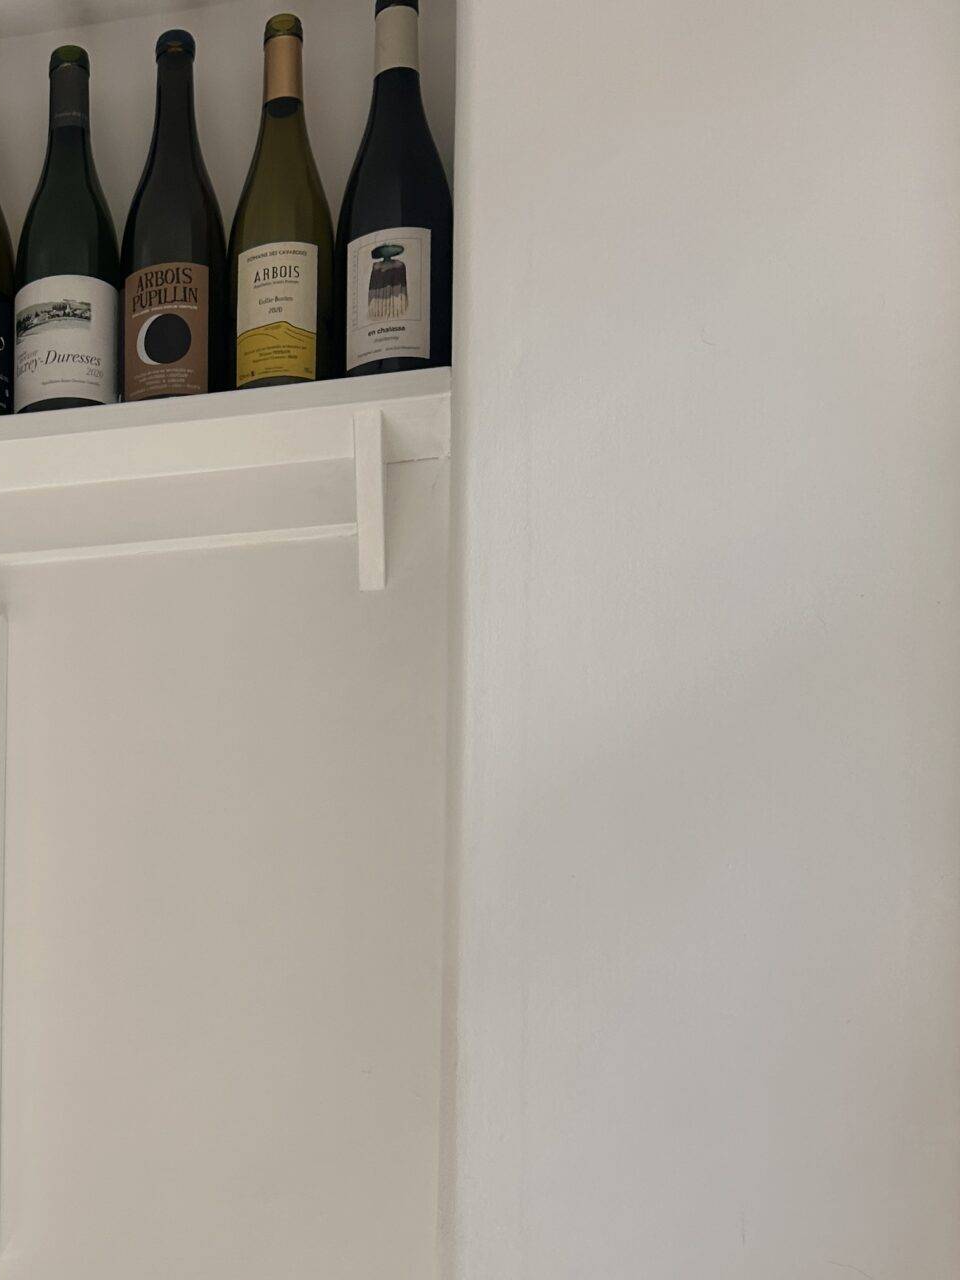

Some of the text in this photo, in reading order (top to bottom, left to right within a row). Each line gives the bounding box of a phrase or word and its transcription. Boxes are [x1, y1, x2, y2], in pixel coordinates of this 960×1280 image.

[136, 267, 193, 294] ARBOIS
[253, 265, 300, 284] ARBOIS
[132, 286, 199, 313] PUPILLIN
